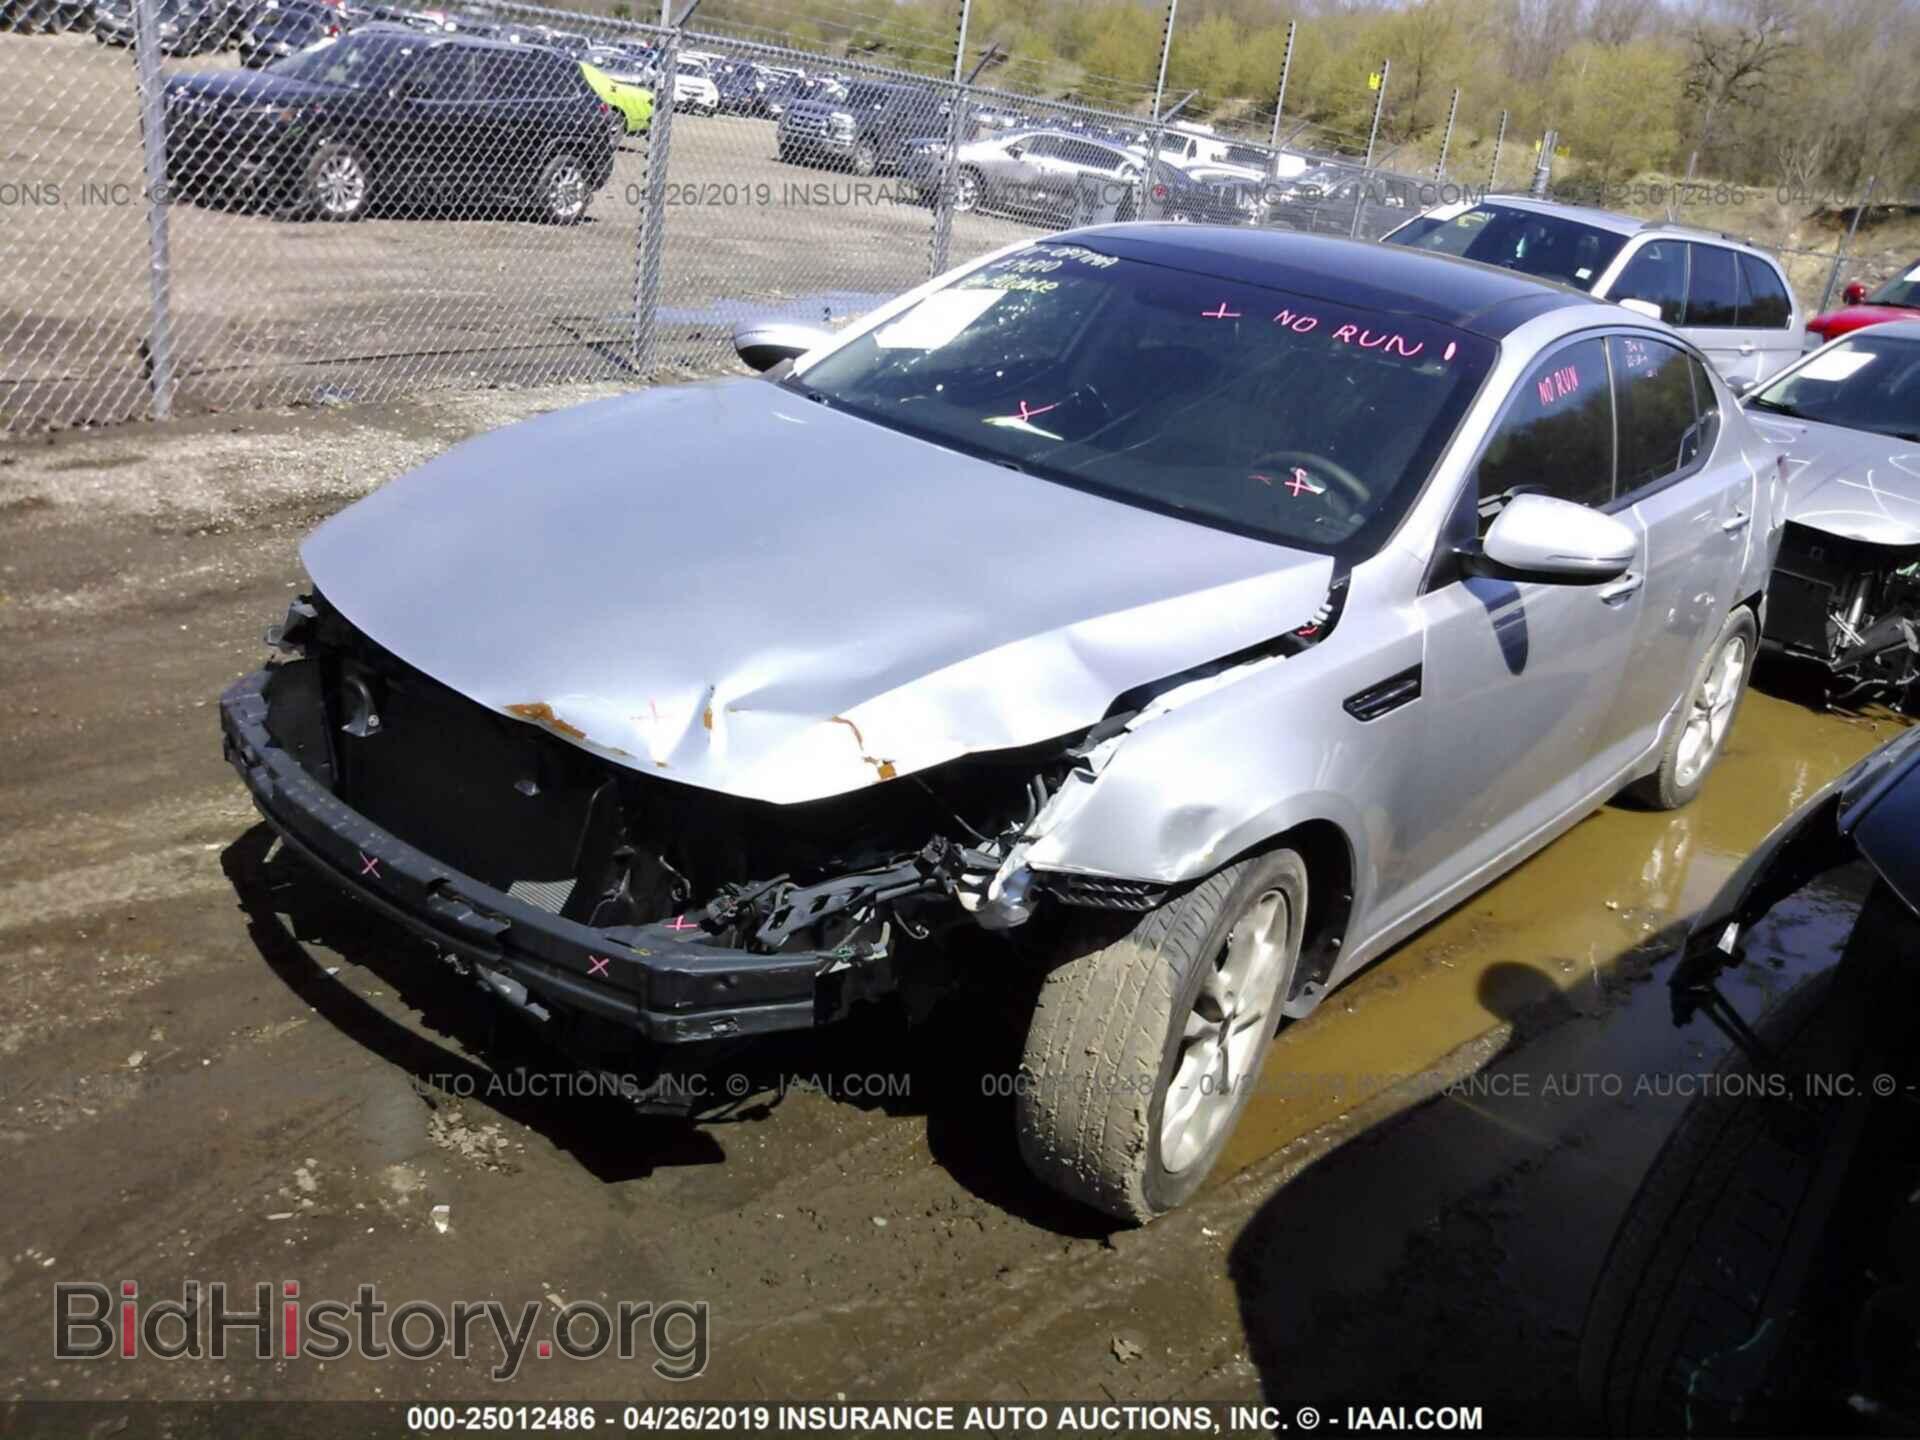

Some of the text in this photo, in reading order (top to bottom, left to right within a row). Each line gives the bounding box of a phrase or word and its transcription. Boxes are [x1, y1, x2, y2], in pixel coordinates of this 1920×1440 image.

[1273, 309, 1423, 357] NO RUN
[1537, 365, 1579, 406] NO RUN
